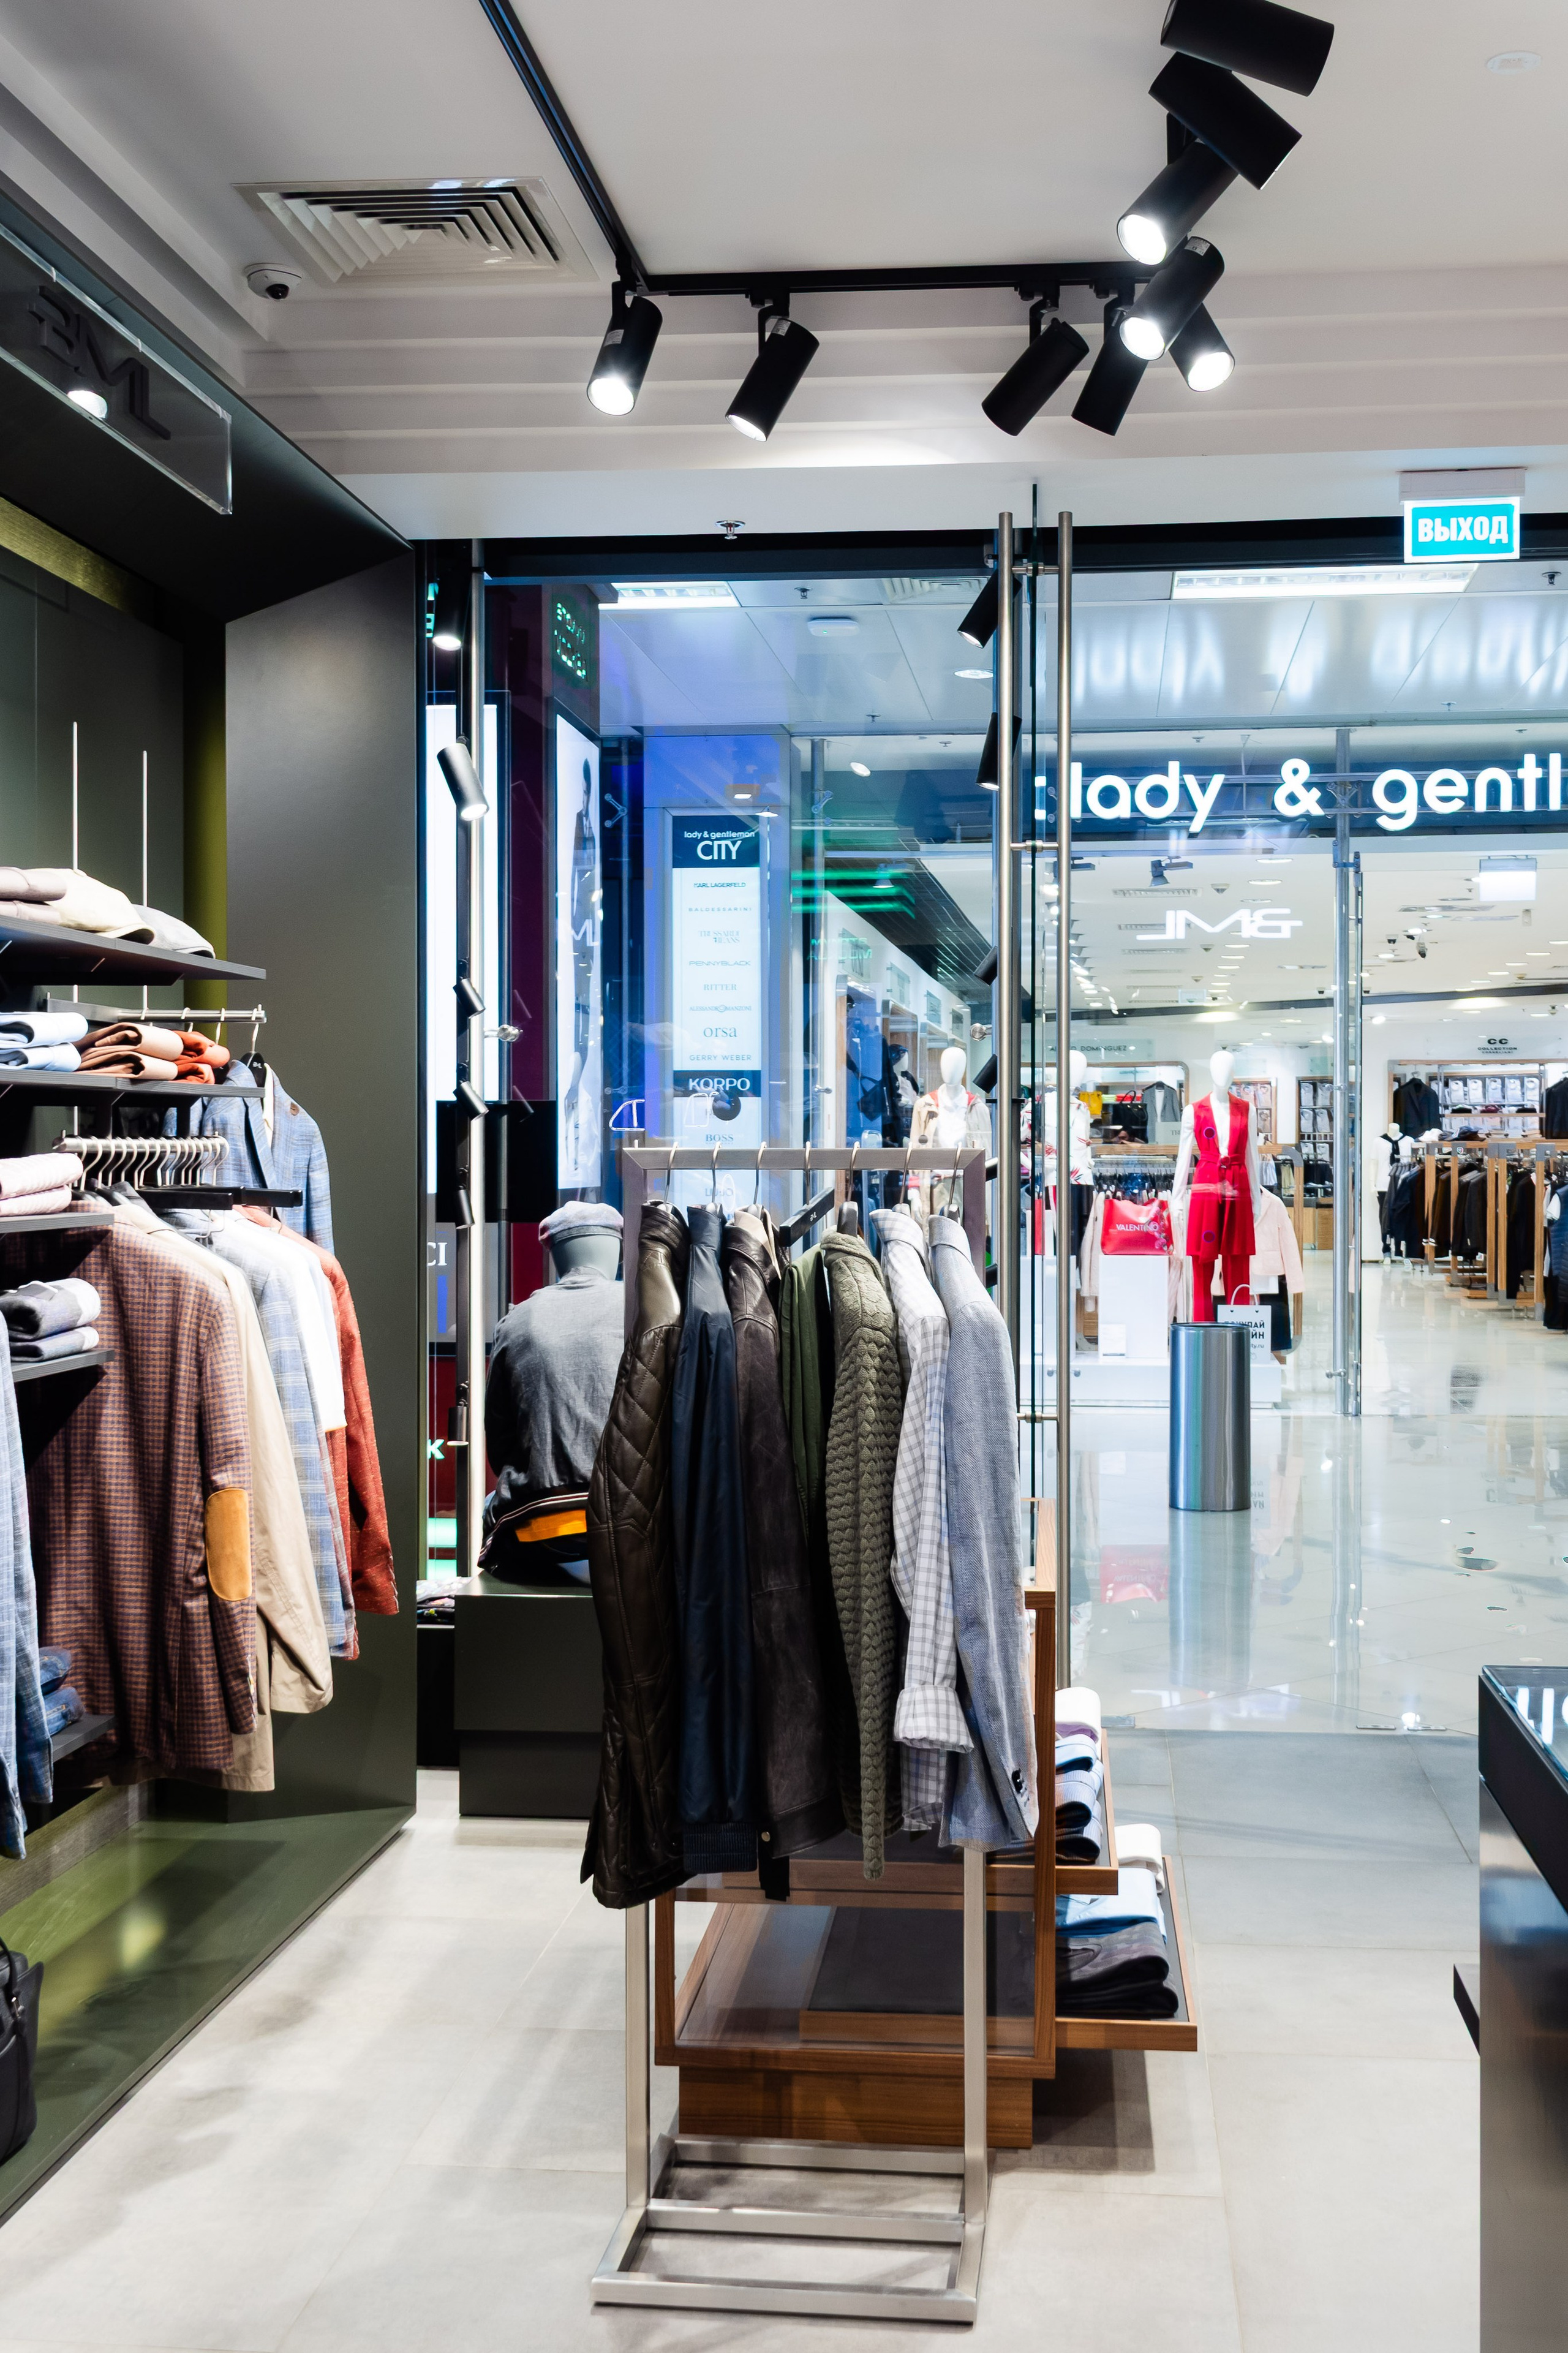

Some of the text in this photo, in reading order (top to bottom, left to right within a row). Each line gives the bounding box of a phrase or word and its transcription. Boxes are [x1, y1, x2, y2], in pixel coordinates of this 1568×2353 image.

[1417, 515, 1509, 544] ВЫХОД
[1070, 752, 1561, 833] lady & gentl
[710, 831, 755, 839] gentleman
[696, 840, 742, 860] CITY
[703, 1027, 737, 1037] orsa
[688, 1078, 751, 1090] KORPO
[706, 1133, 734, 1142] BOSS
